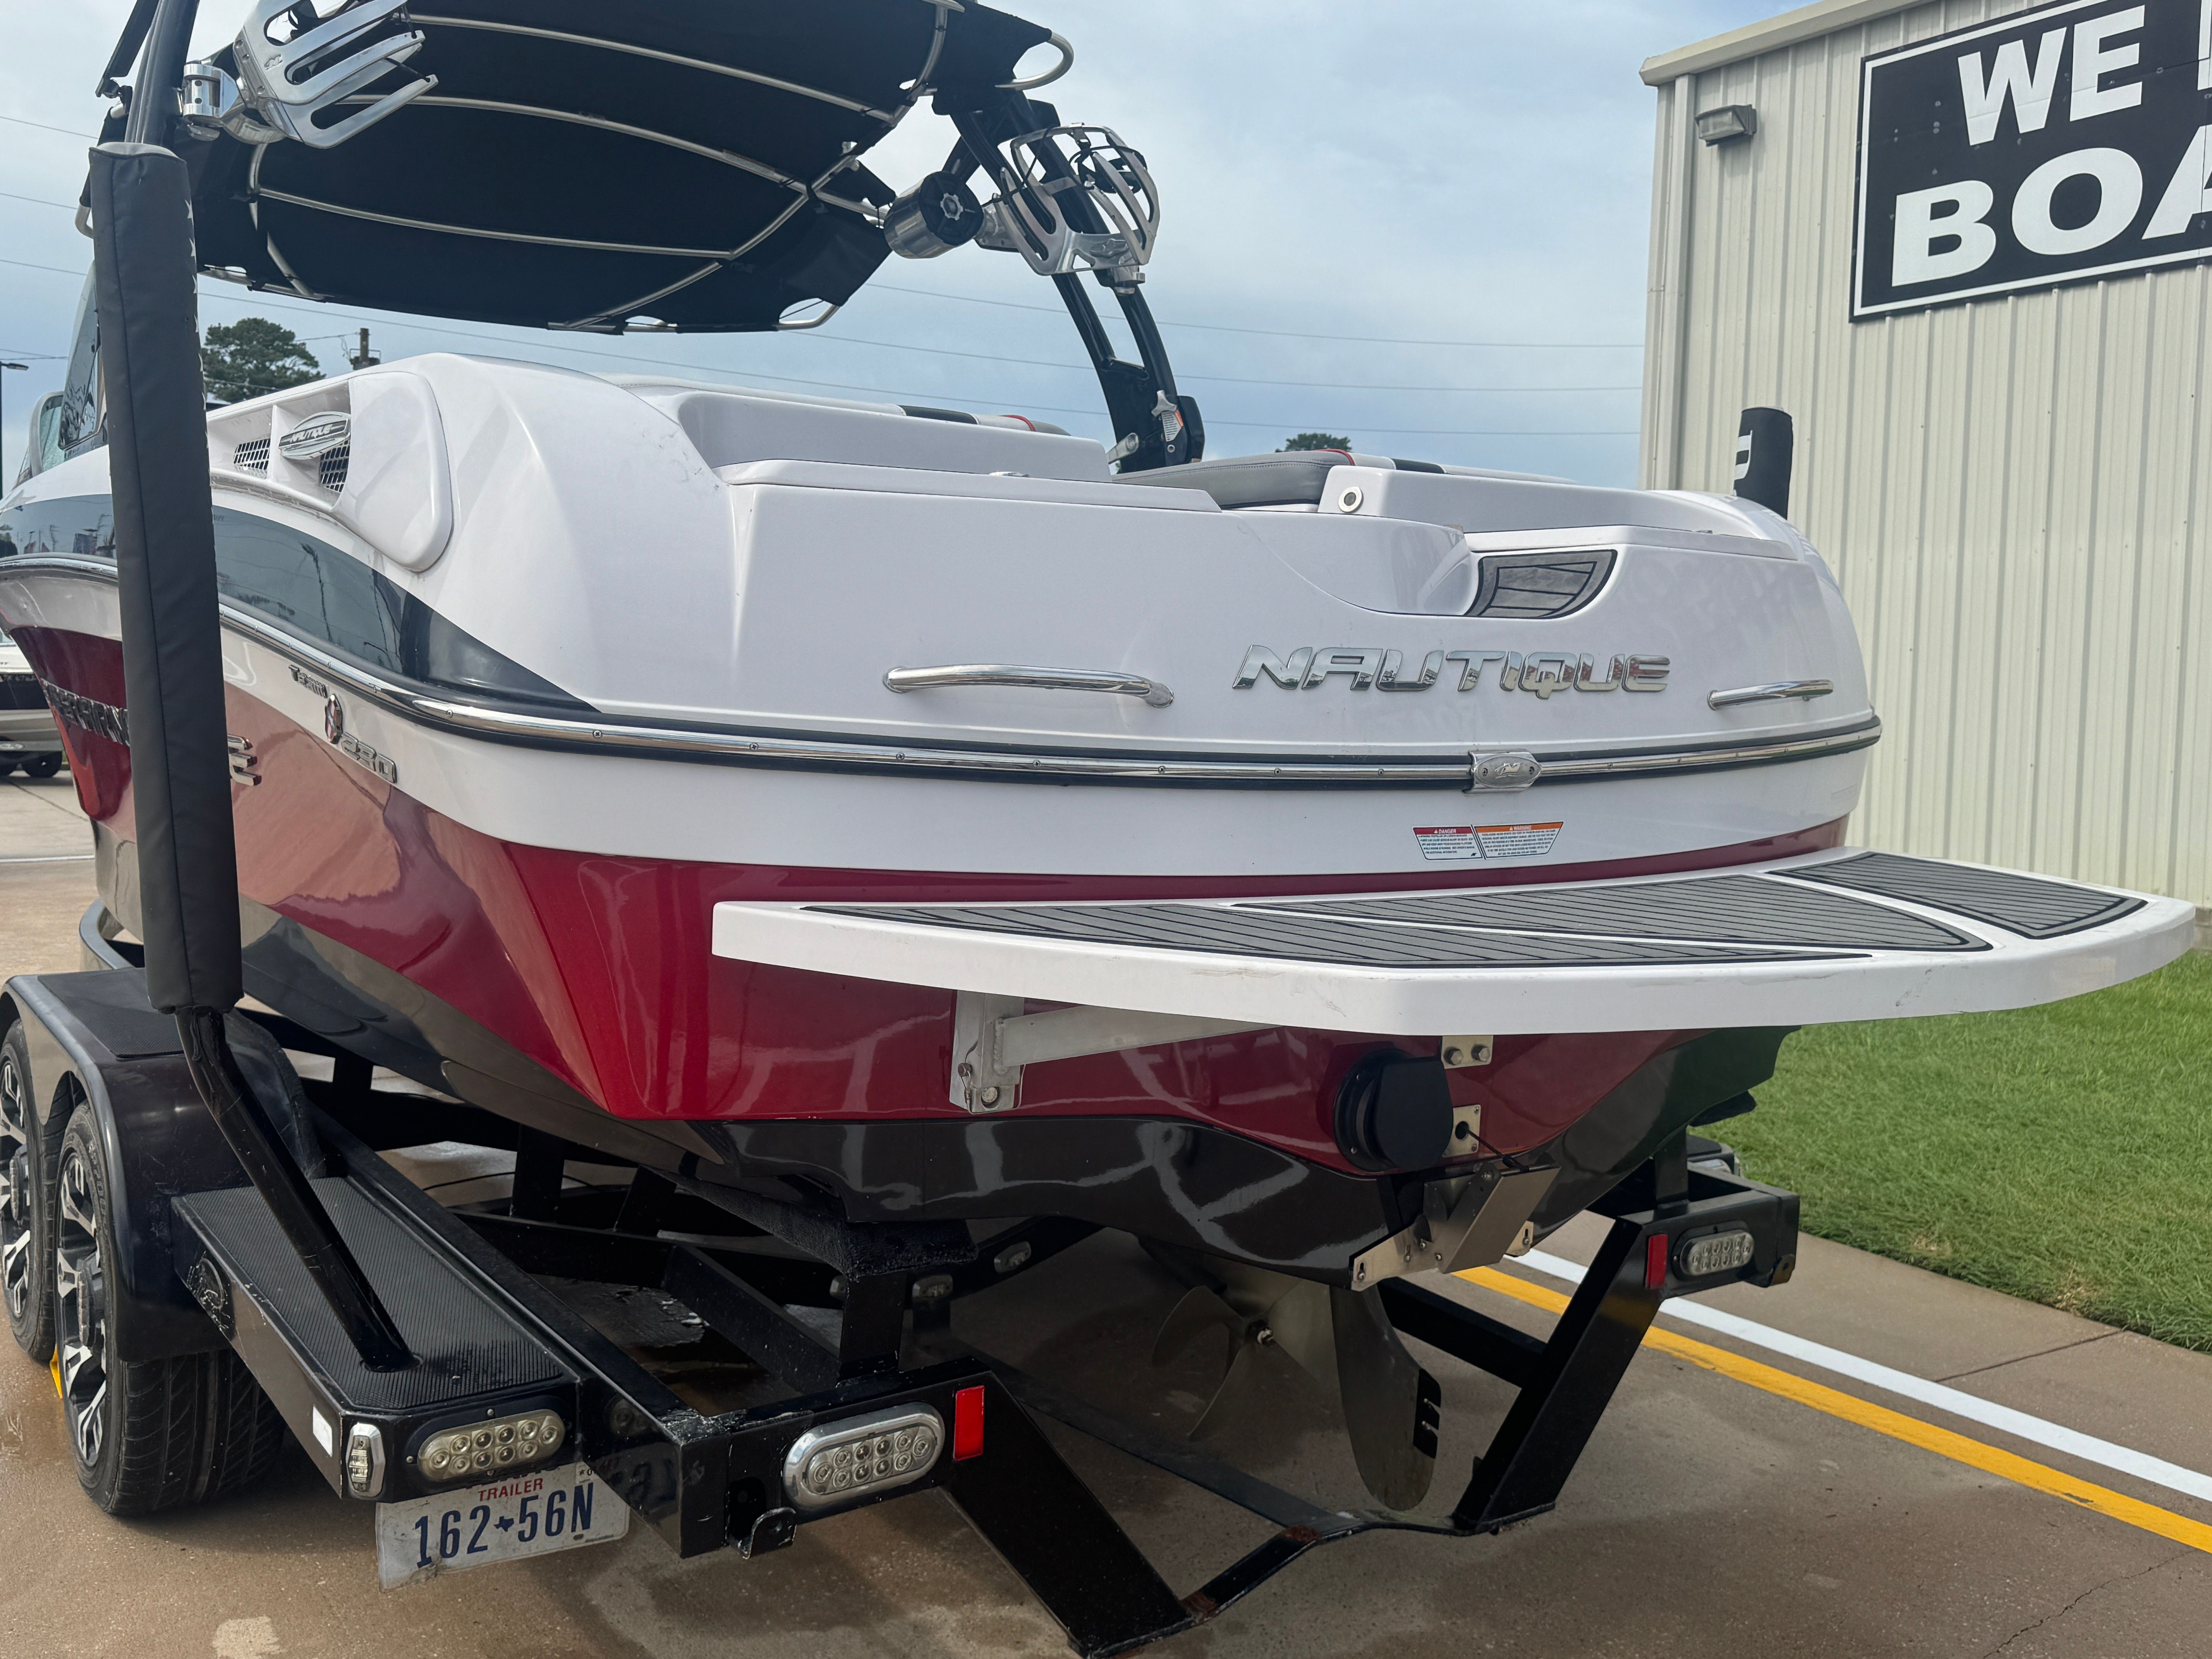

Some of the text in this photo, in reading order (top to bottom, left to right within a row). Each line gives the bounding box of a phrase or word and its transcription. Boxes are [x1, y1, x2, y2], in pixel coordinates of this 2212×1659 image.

[1958, 5, 2145, 146] WE
[290, 424, 333, 443] NAUTIQUE
[1232, 645, 1671, 699] NAUTIQUE
[341, 732, 397, 784] 230
[478, 1478, 544, 1501] TRAILER
